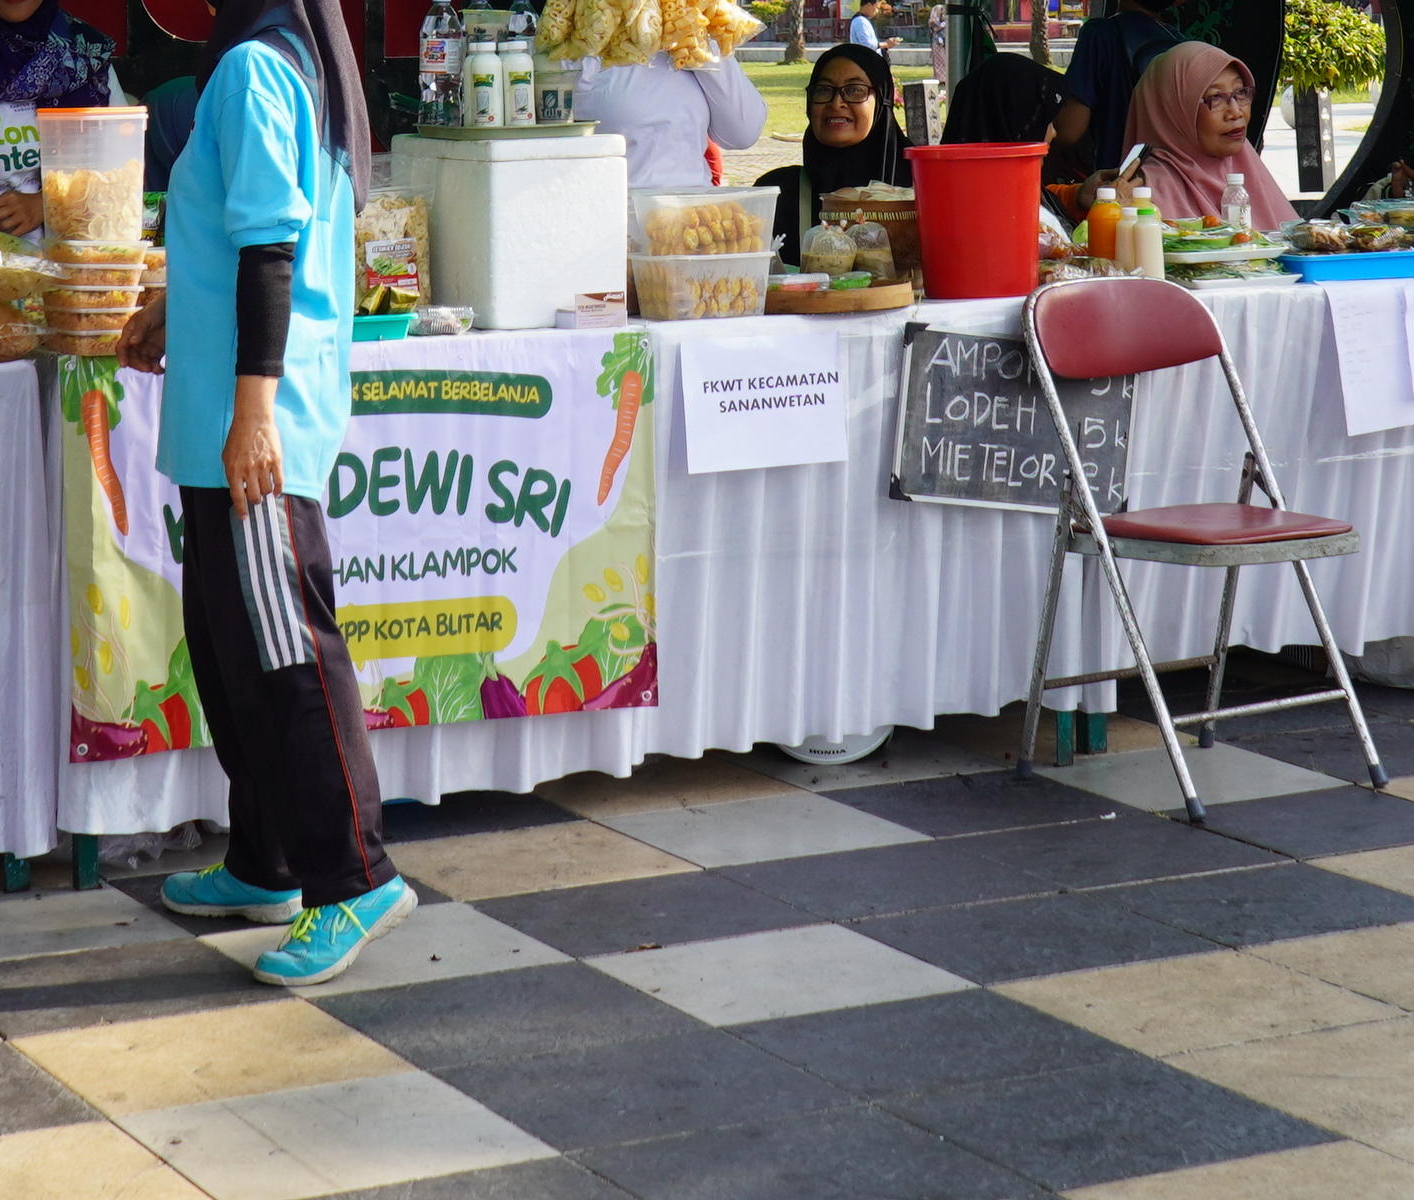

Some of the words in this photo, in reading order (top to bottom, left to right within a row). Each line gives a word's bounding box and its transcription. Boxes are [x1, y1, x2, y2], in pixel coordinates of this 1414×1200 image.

[925, 337, 1035, 388] AMPO
[362, 380, 438, 401] SELAMAT
[441, 380, 540, 404] BERBELANJA
[703, 377, 744, 394] FKWT
[747, 371, 839, 391] KECAMATAN
[719, 393, 826, 414] SANANWETAN
[925, 382, 1037, 435] LODEH
[921, 436, 972, 482] MIE
[979, 443, 1058, 489] TELOR
[327, 446, 474, 519] DEWI
[485, 460, 571, 538] SRI
[391, 547, 518, 581] KLAMPOK
[374, 615, 431, 640] KOTA
[436, 611, 503, 636] BLITAR
